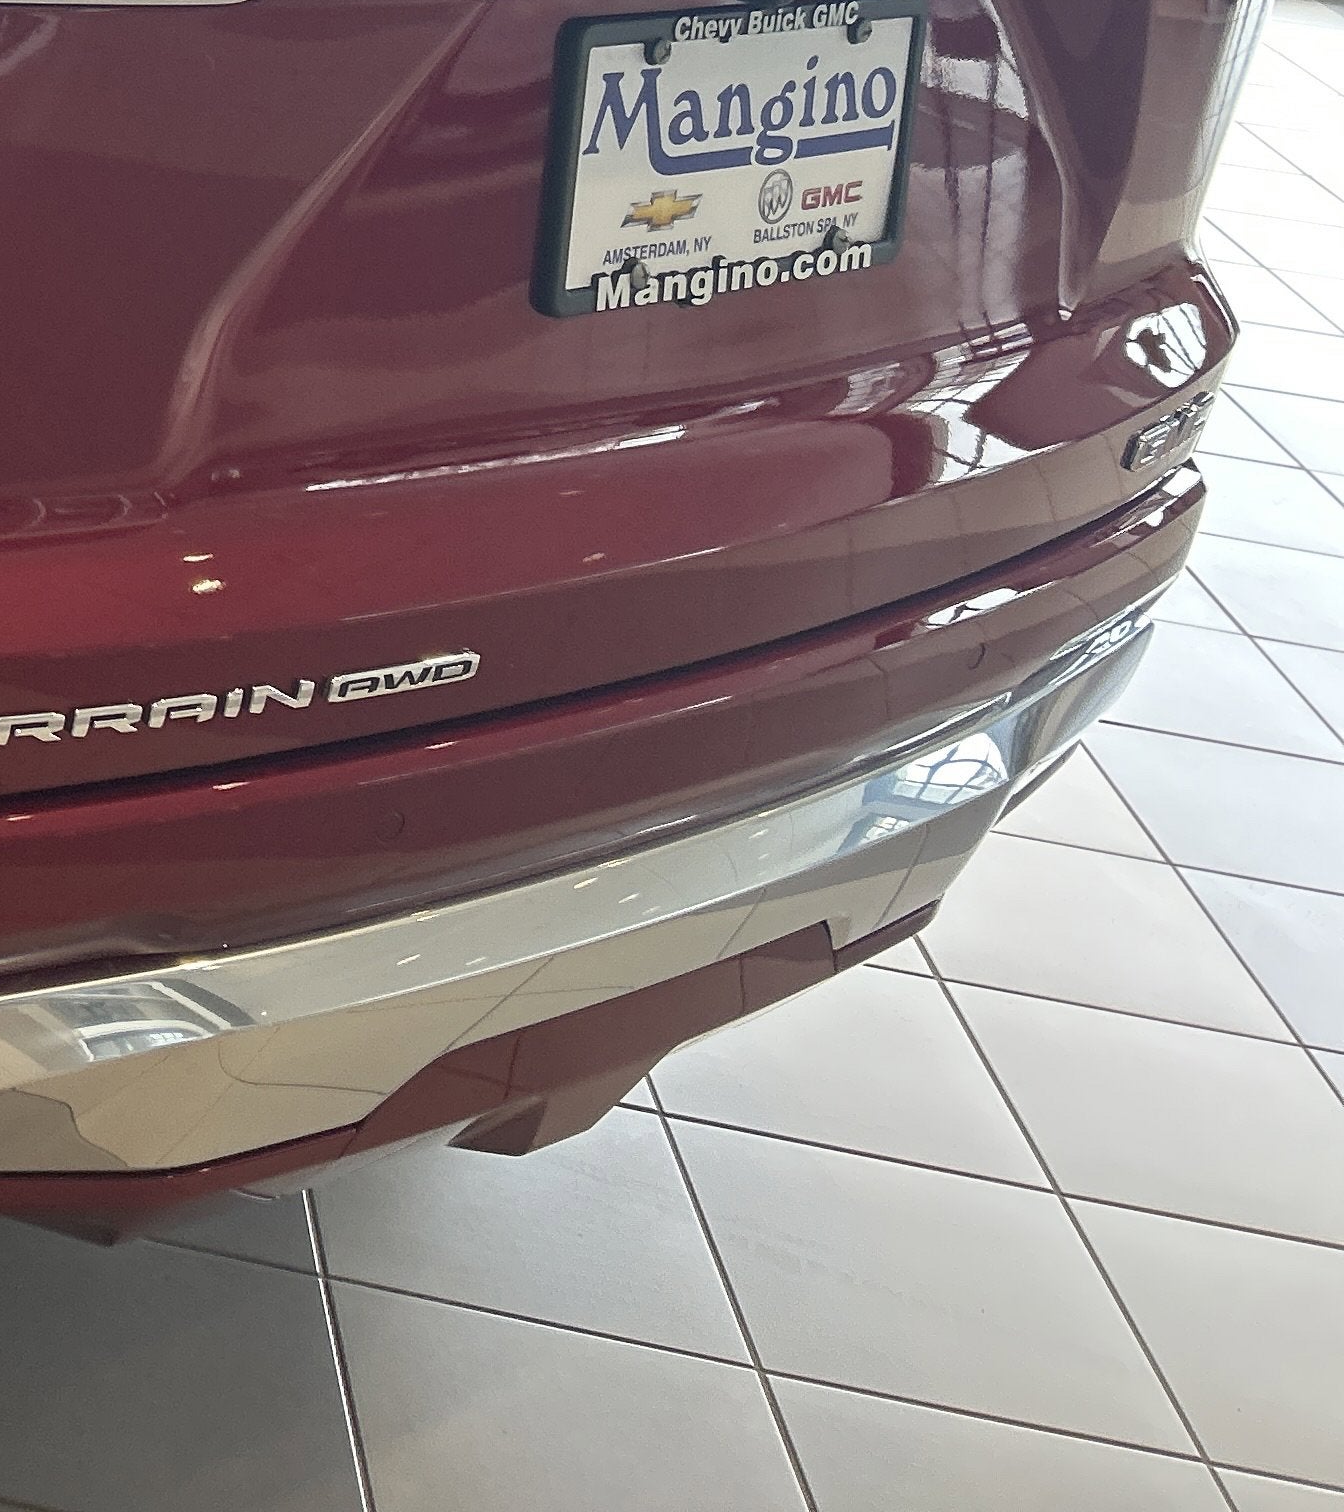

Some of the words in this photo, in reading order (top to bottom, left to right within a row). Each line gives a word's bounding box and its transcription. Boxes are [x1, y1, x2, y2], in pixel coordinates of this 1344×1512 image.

[674, 15, 741, 43] Chevy
[748, 6, 806, 35] Buick
[813, 1, 860, 27] GMC
[582, 54, 897, 175] Mangino
[800, 180, 864, 211] GMC
[753, 221, 815, 244] BALLSTON
[843, 212, 859, 230] NY
[602, 239, 691, 265] AMSTERDAM,
[692, 236, 712, 253] NY
[596, 241, 872, 312] Mangino.com
[331, 654, 477, 700] AWD
